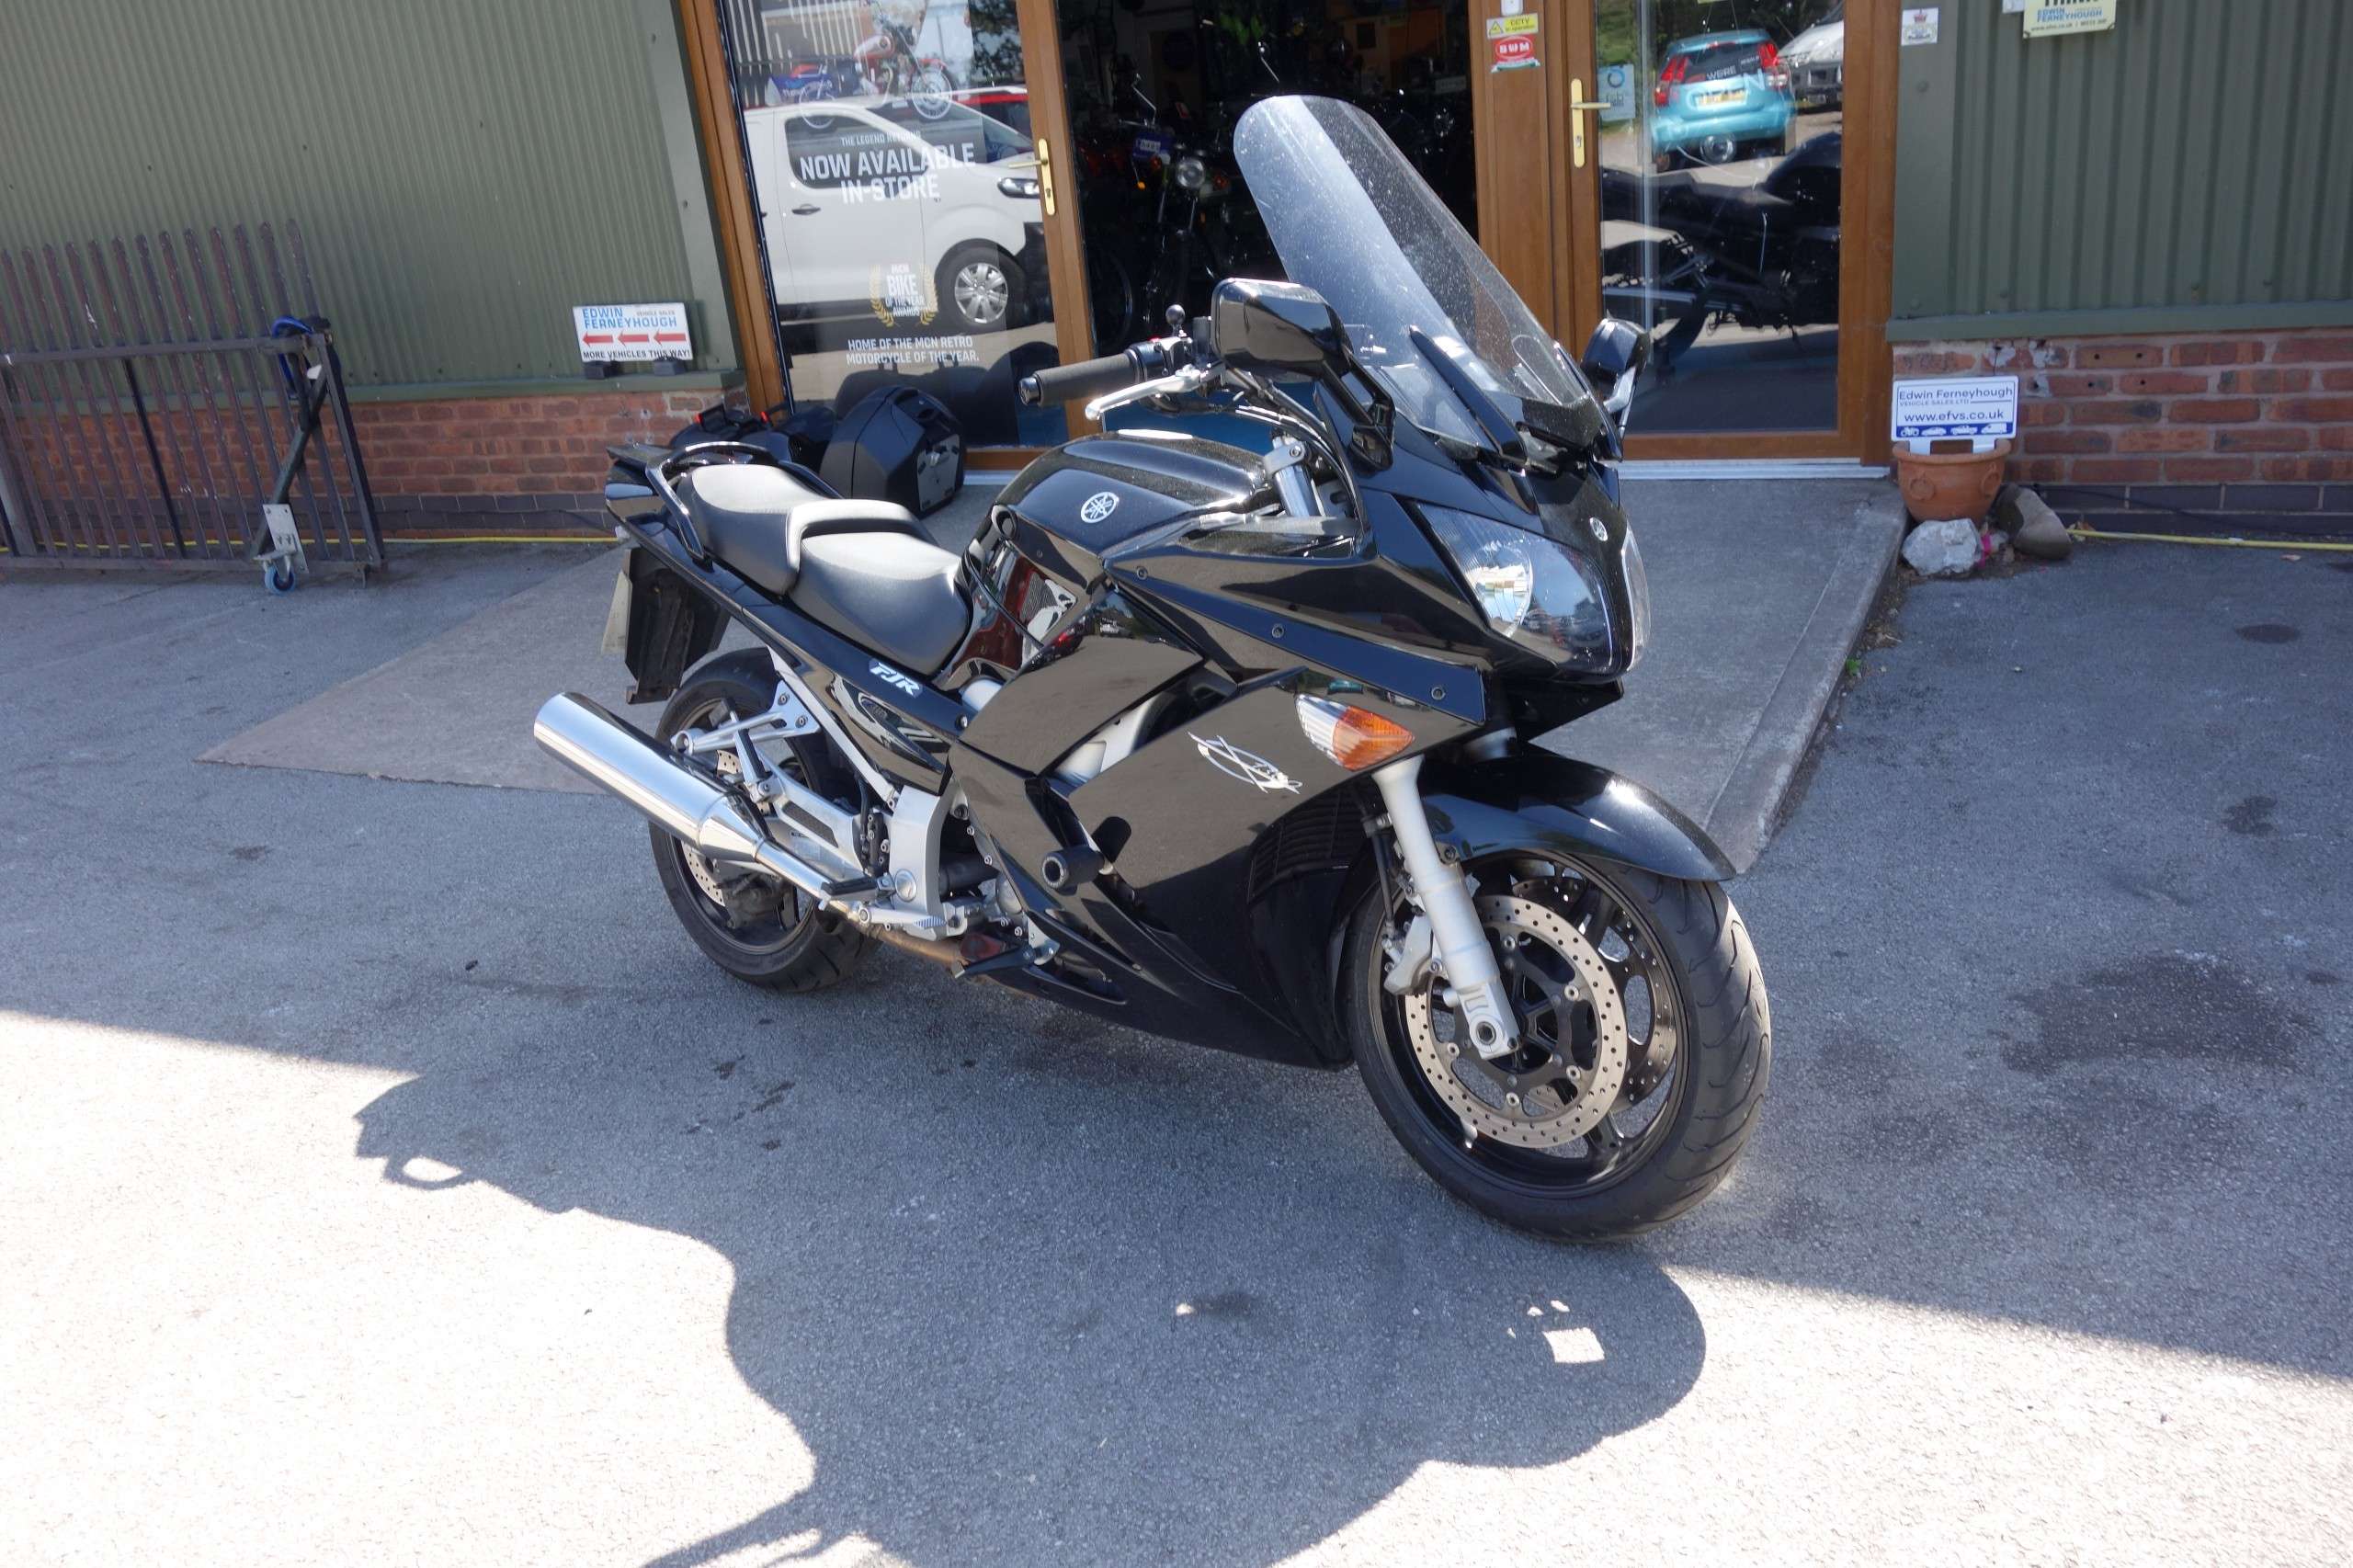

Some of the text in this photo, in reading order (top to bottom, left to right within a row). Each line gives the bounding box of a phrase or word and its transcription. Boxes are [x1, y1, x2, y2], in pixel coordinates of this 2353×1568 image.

[840, 136, 855, 147] THE
[857, 133, 885, 145] LEGEND
[800, 142, 976, 180] NOW AVAILABLE
[841, 175, 941, 204] IN-STORE
[886, 274, 918, 296] BIKE
[582, 308, 623, 319] EDWIN
[892, 307, 920, 317] AWARDS
[584, 316, 677, 329] FERNEYHOUGH
[847, 335, 973, 351] HOME OF THE MCN RETRO
[583, 348, 690, 360] MORE VEHICLES THIS WAY!
[846, 349, 980, 365] MOTORCYCLE OF THE YEAR.
[1899, 387, 2013, 401] Edwin Ferneyhough
[1904, 409, 2004, 422] www.efvs.co.uk
[870, 662, 920, 695] FJR
